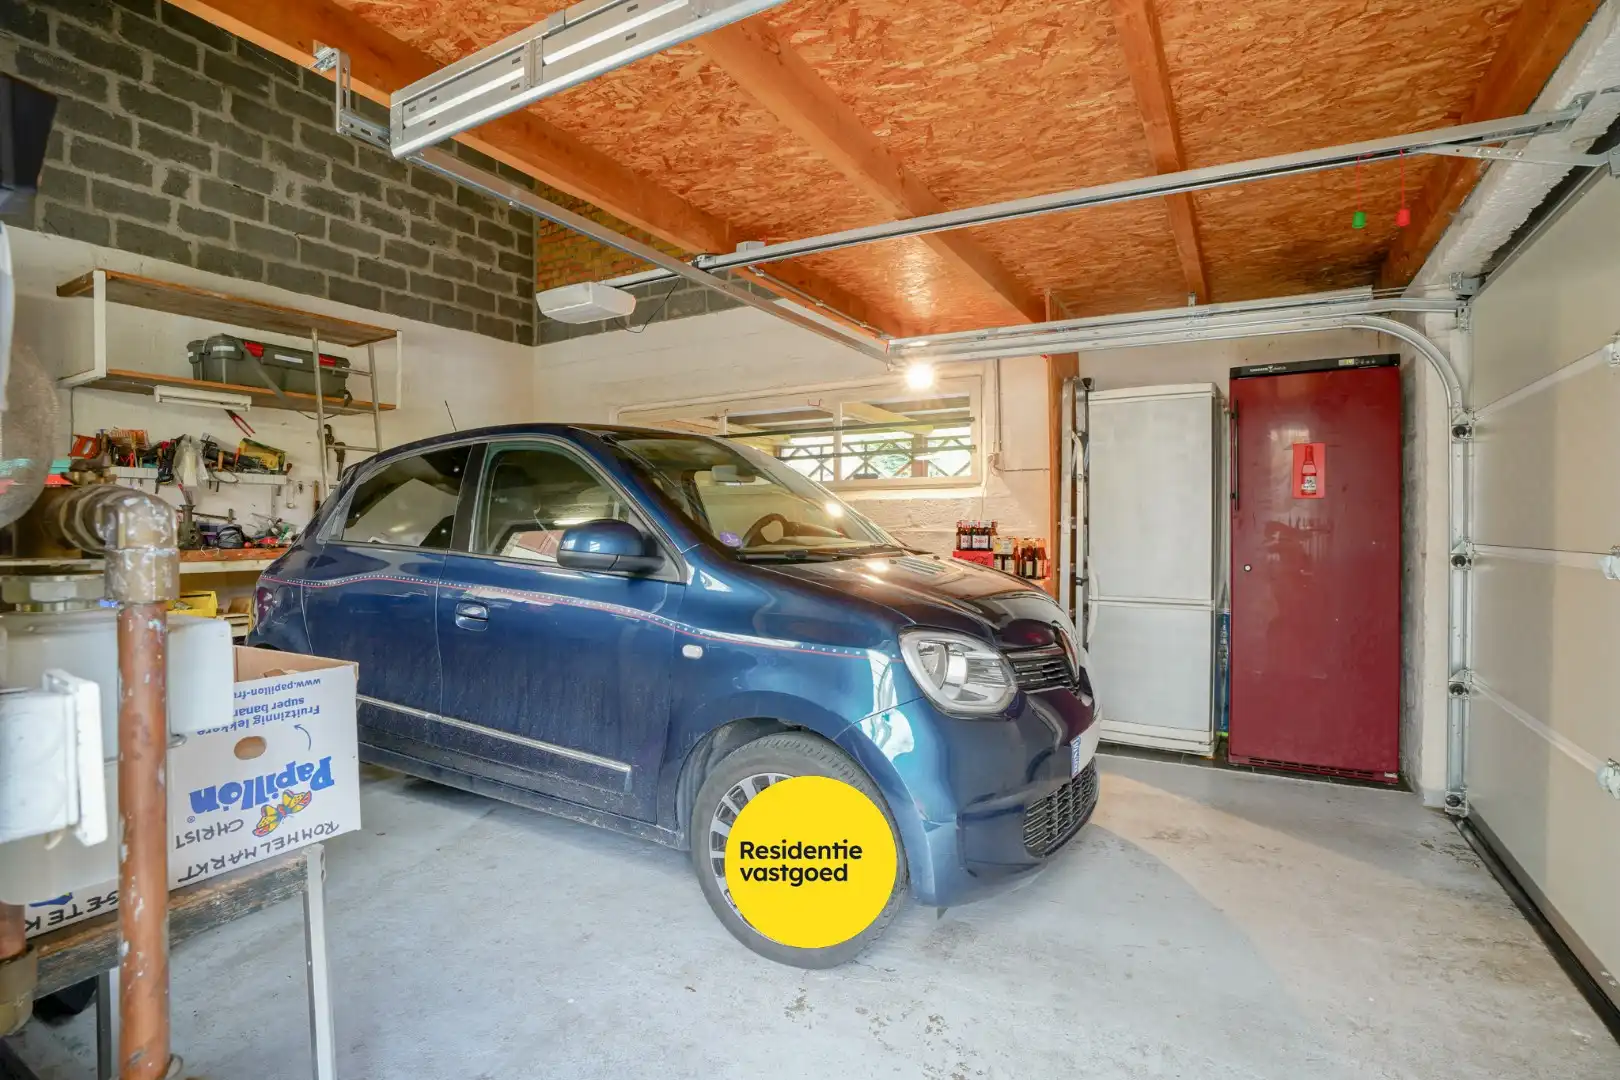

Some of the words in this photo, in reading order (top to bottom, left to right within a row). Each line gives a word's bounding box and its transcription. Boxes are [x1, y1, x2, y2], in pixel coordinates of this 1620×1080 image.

[252, 704, 320, 726] Fruitzinnig
[271, 697, 305, 712] super
[189, 755, 335, 816] Papillon
